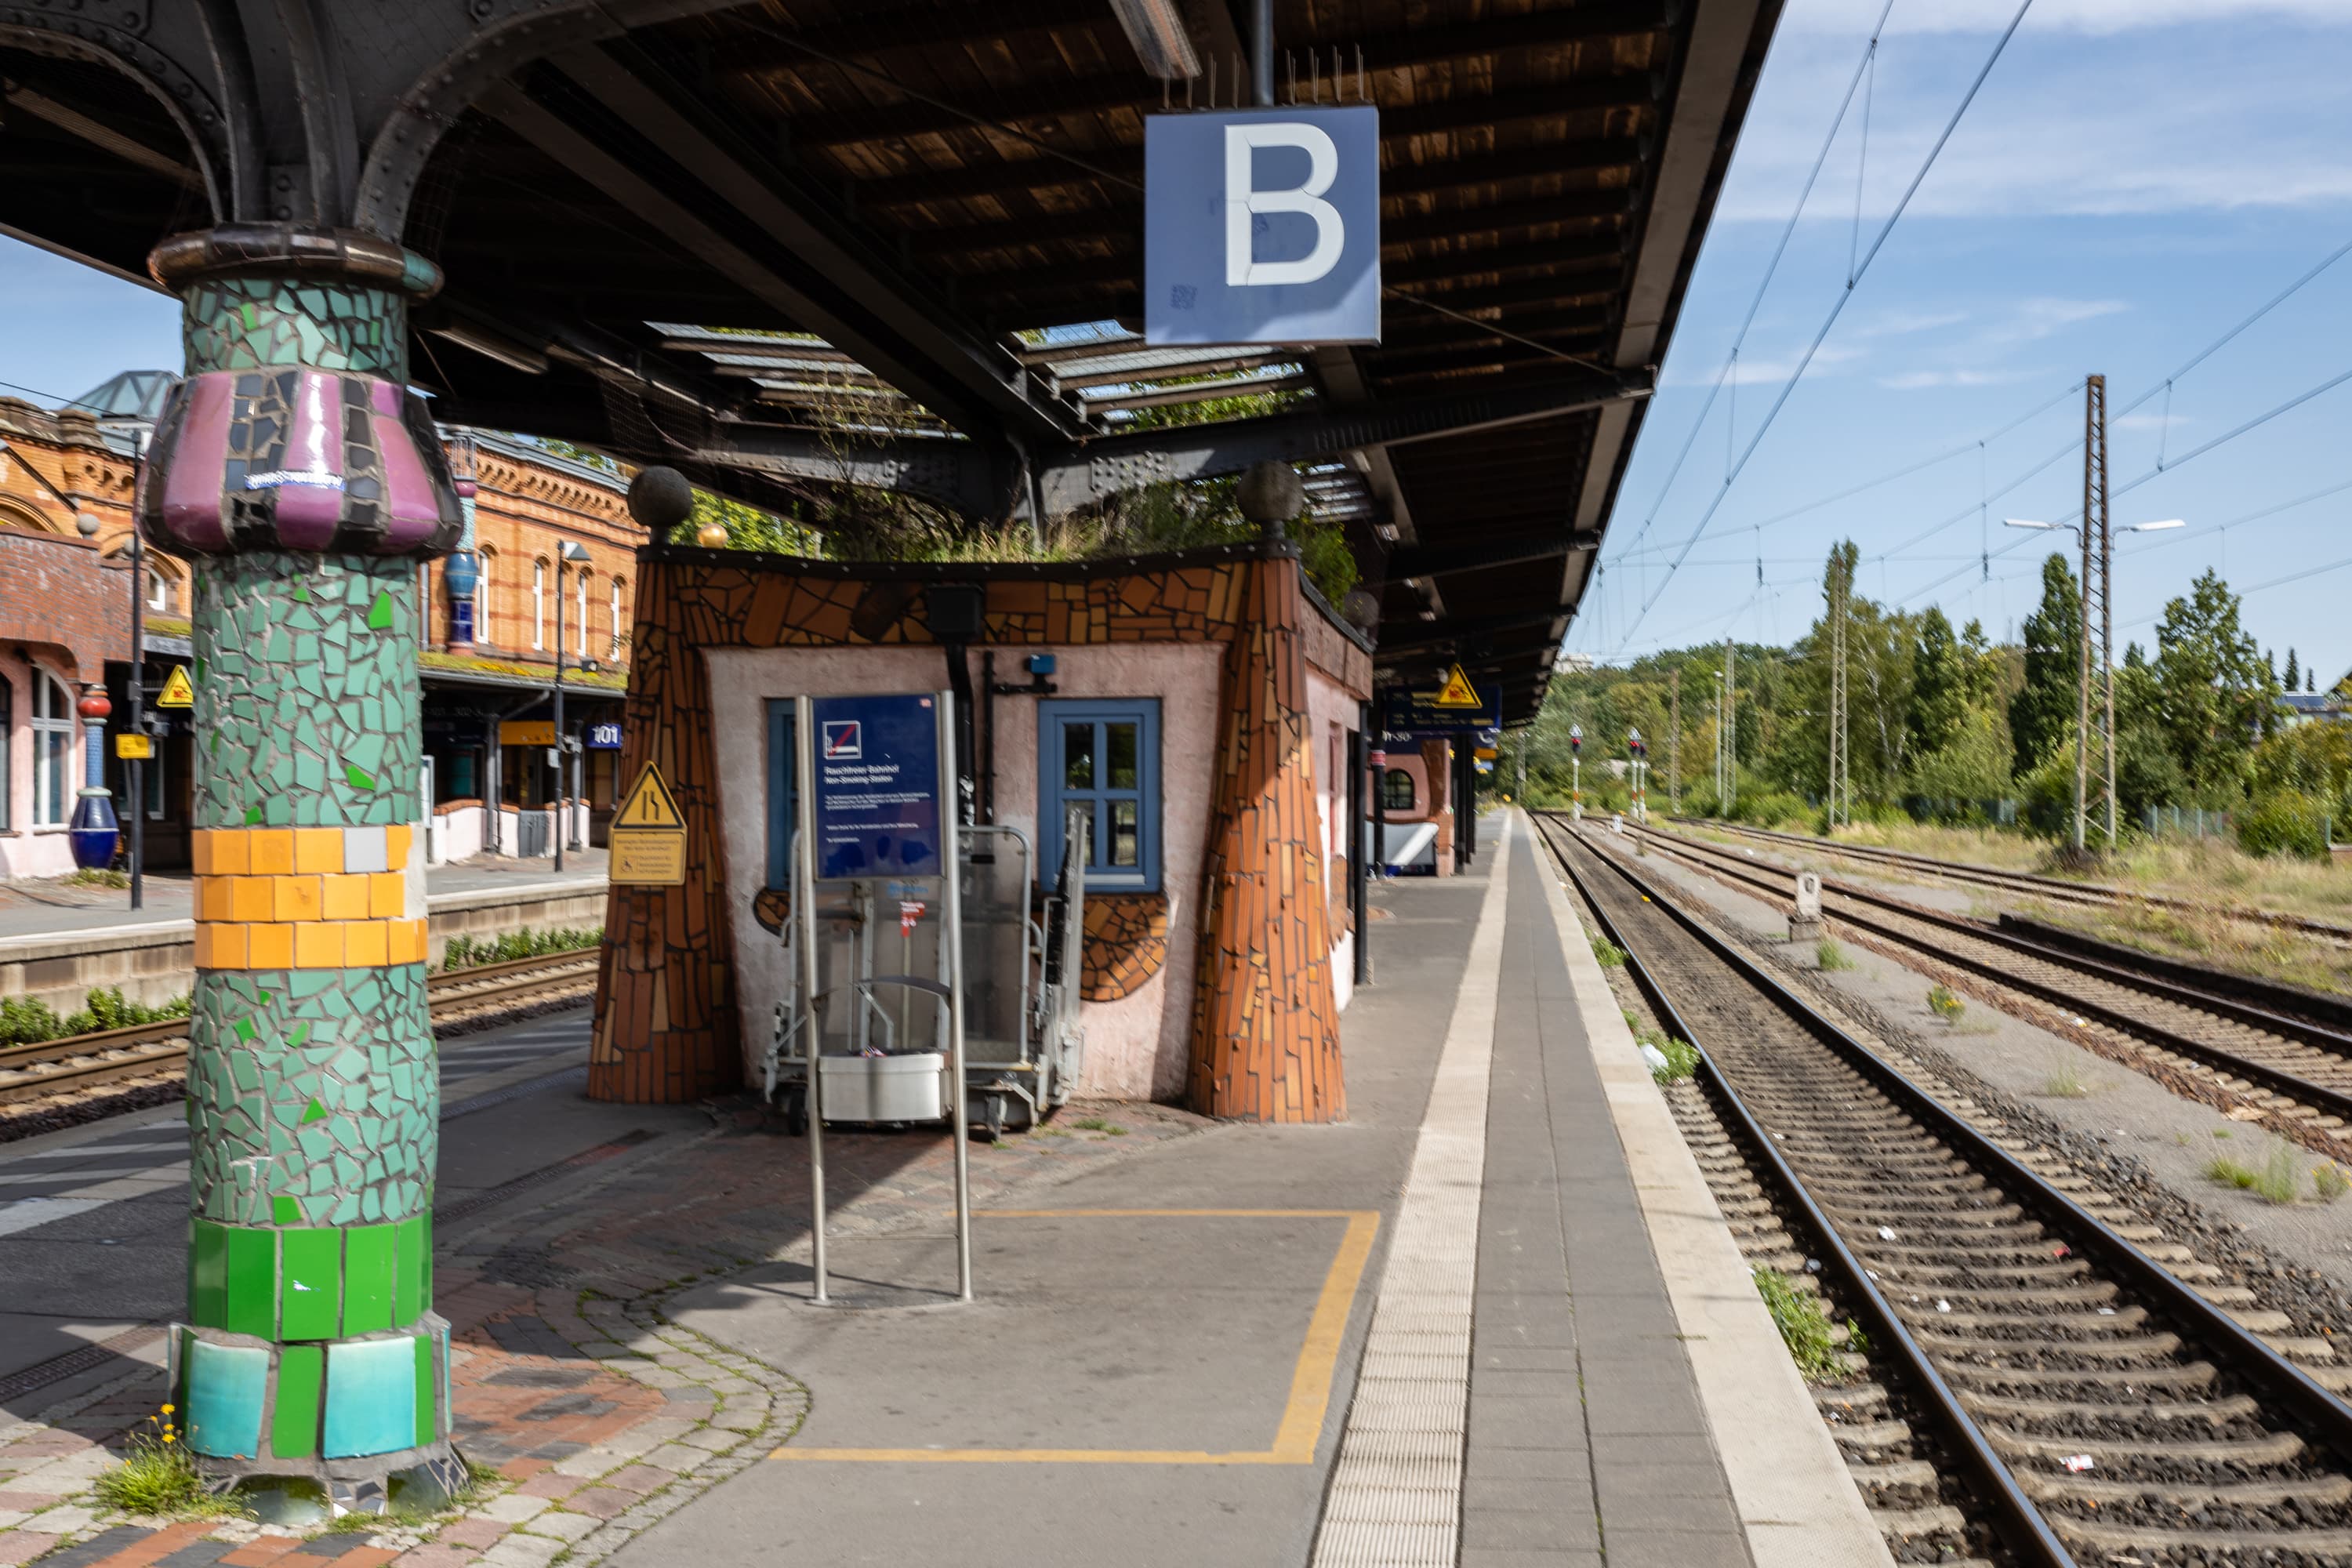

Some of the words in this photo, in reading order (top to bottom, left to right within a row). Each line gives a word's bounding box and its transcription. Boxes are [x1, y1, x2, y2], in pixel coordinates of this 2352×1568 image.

[1224, 123, 1345, 287] B
[592, 725, 618, 744] 101
[866, 764, 899, 774] Bahnhof
